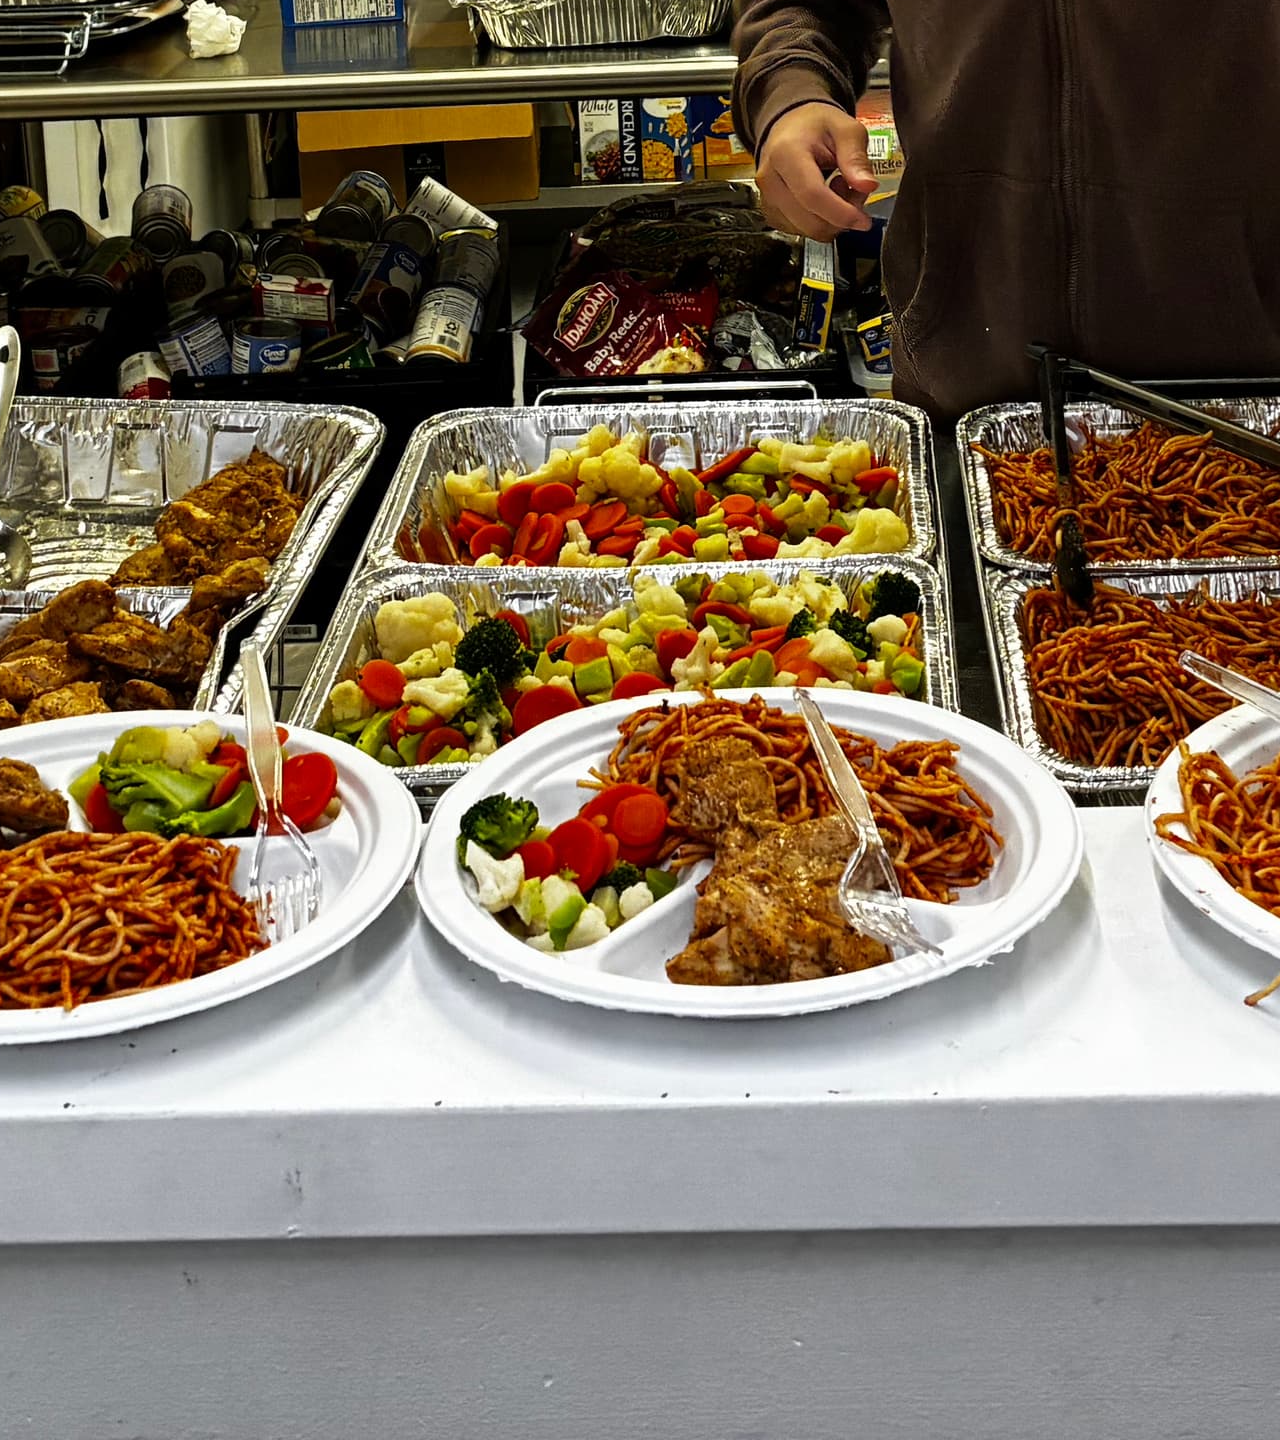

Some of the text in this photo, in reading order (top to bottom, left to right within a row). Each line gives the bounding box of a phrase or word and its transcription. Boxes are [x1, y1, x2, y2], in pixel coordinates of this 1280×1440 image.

[621, 100, 637, 165] RICELAND
[563, 287, 609, 346] IDAHOAN
[584, 341, 616, 373] Baby
[609, 312, 638, 343] Reds
